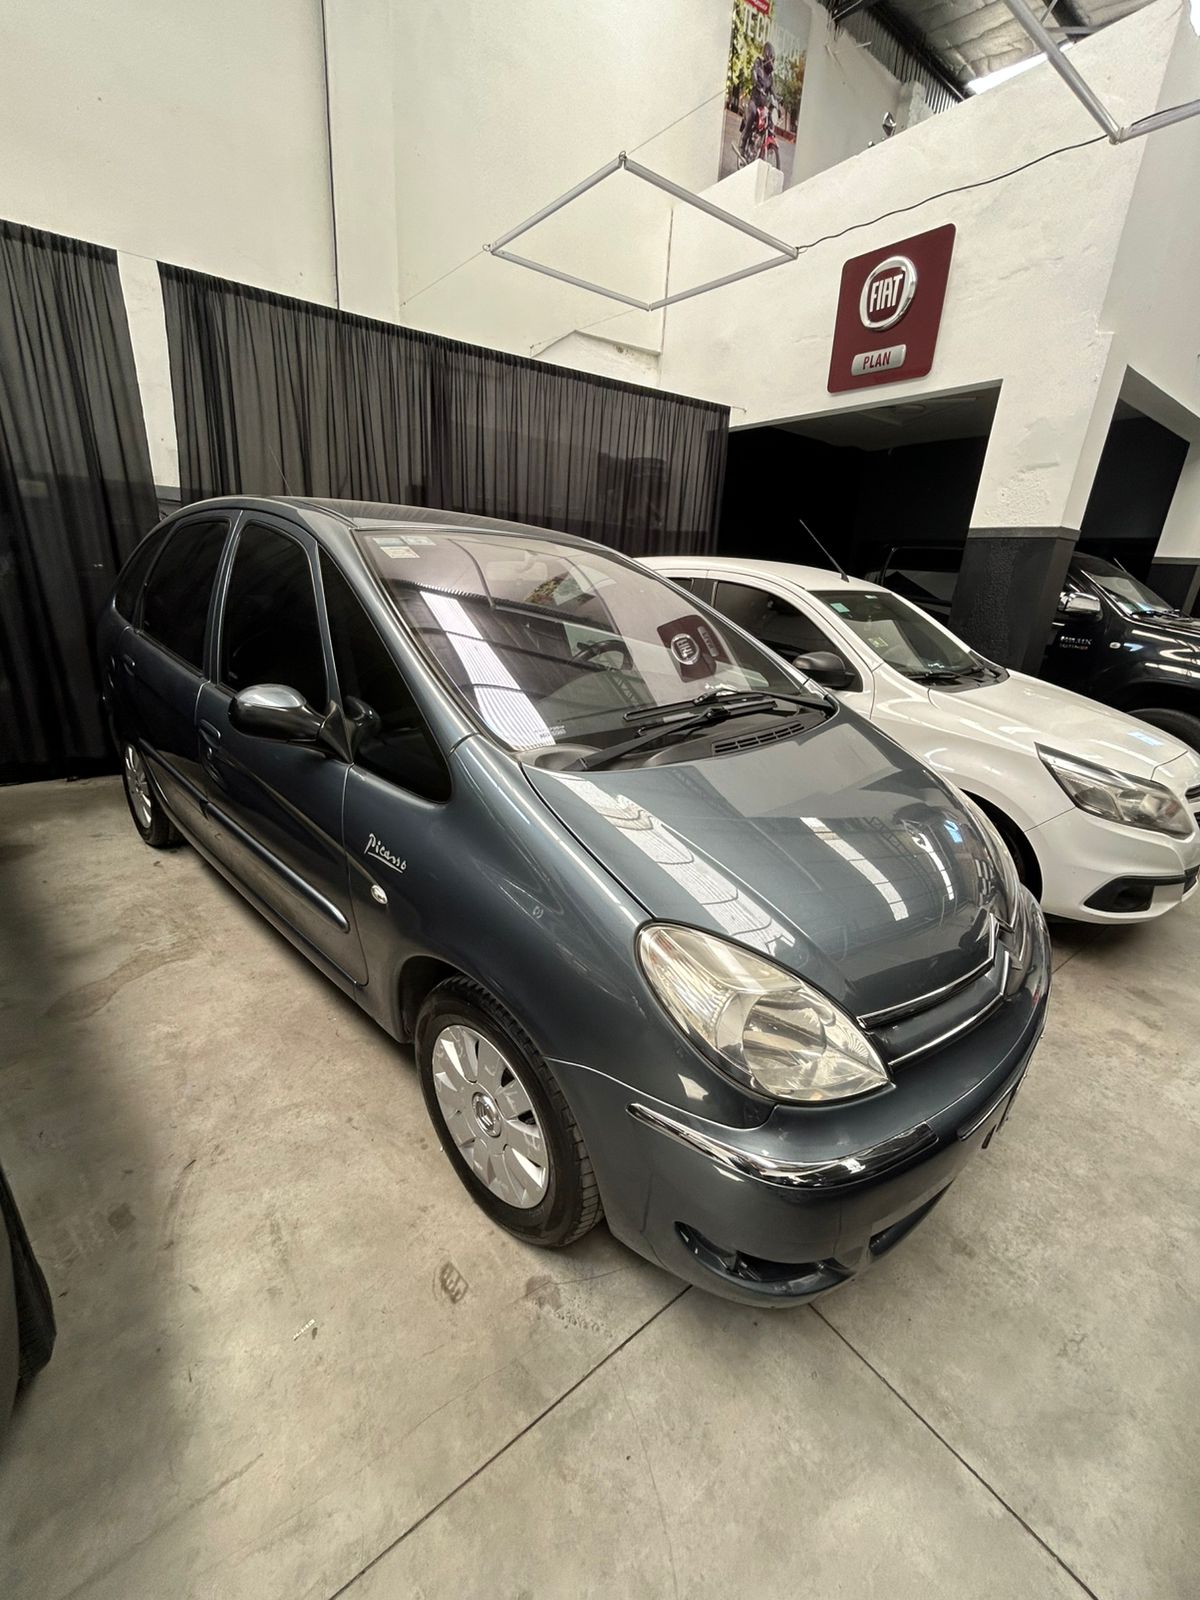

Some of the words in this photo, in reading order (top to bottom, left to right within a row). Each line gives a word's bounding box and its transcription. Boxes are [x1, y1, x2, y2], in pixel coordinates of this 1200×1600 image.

[869, 273, 904, 313] FIAT
[862, 351, 891, 370] PLAN
[363, 832, 407, 871] Picasso
